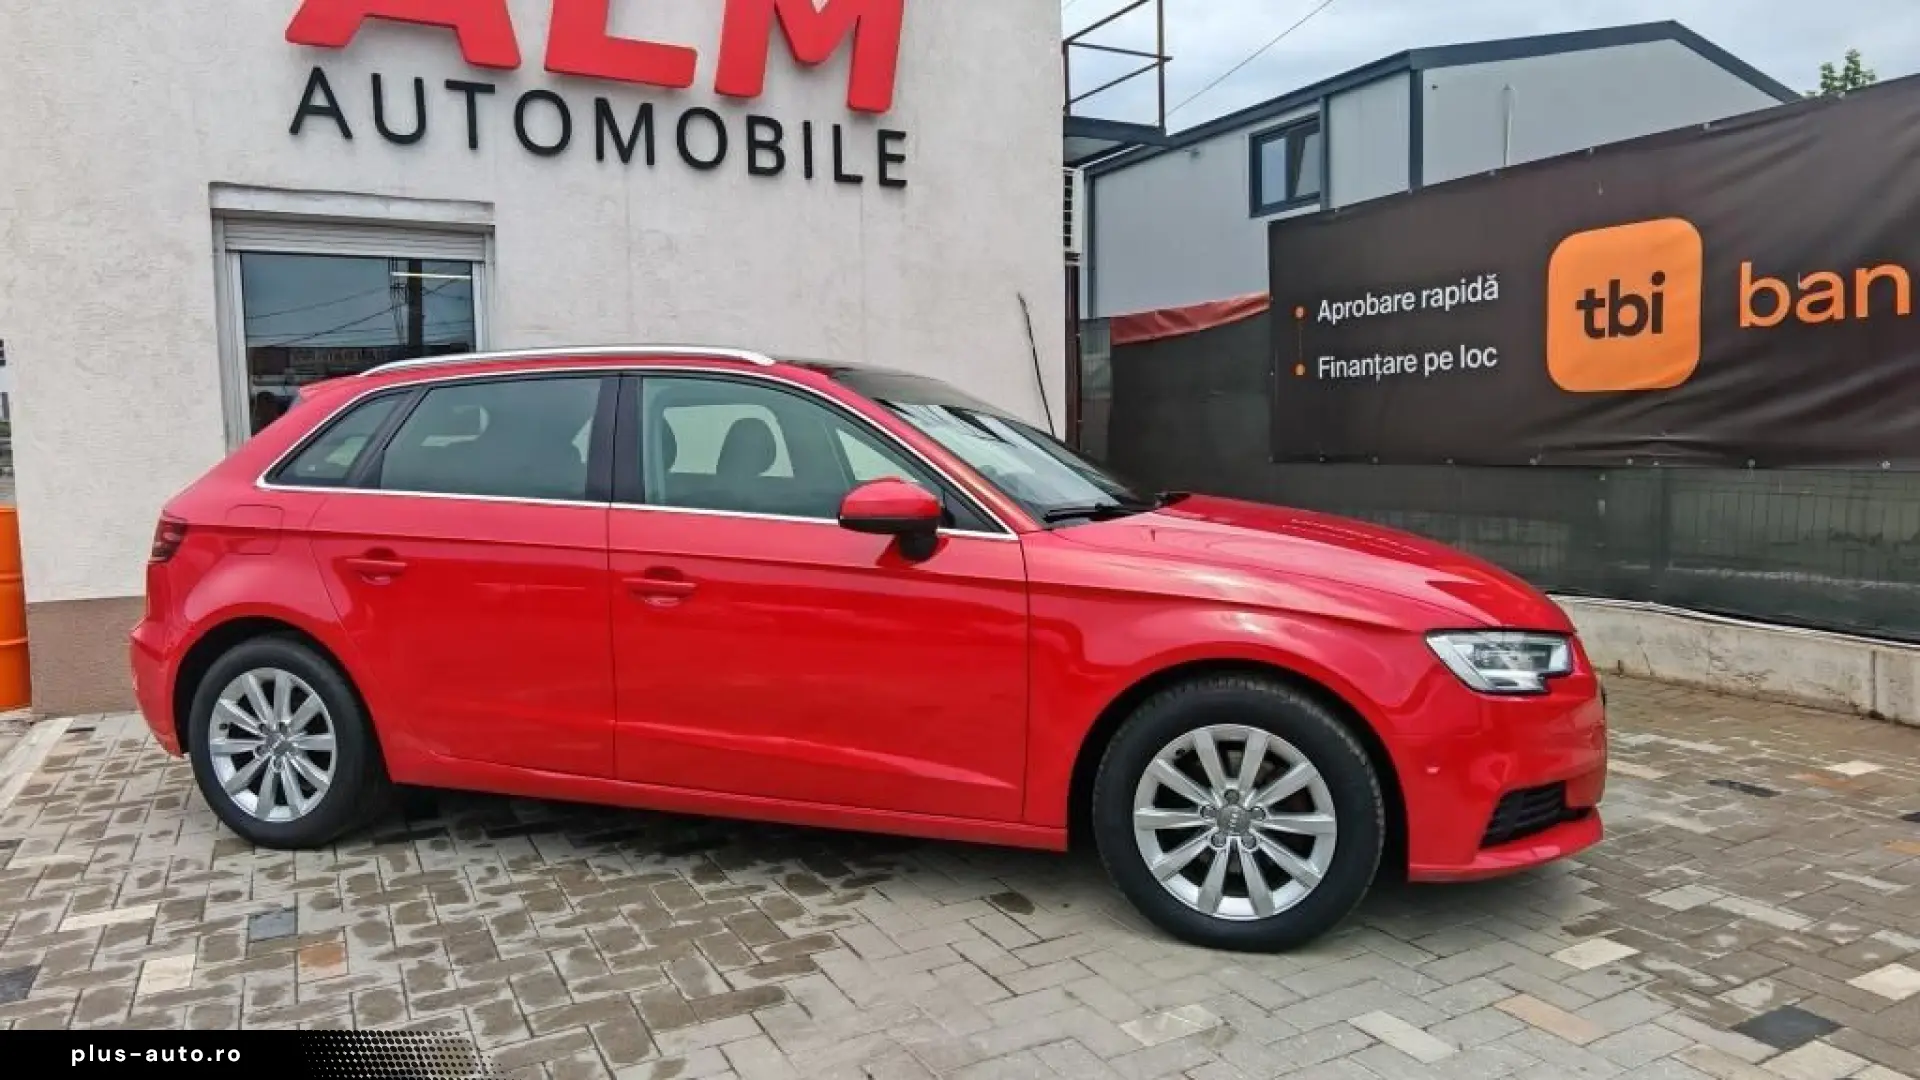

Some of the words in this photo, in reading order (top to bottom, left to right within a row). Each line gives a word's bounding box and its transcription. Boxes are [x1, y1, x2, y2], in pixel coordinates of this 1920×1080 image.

[288, 66, 907, 191] AUTOMOBILE
[1316, 285, 1416, 325] Aprobare
[1421, 273, 1500, 312] rapidă
[1574, 269, 1666, 340] tbi
[1739, 261, 1912, 328] ban
[1317, 353, 1418, 382] Finanțare
[1424, 351, 1454, 377] pe
[1459, 344, 1499, 370] loc
